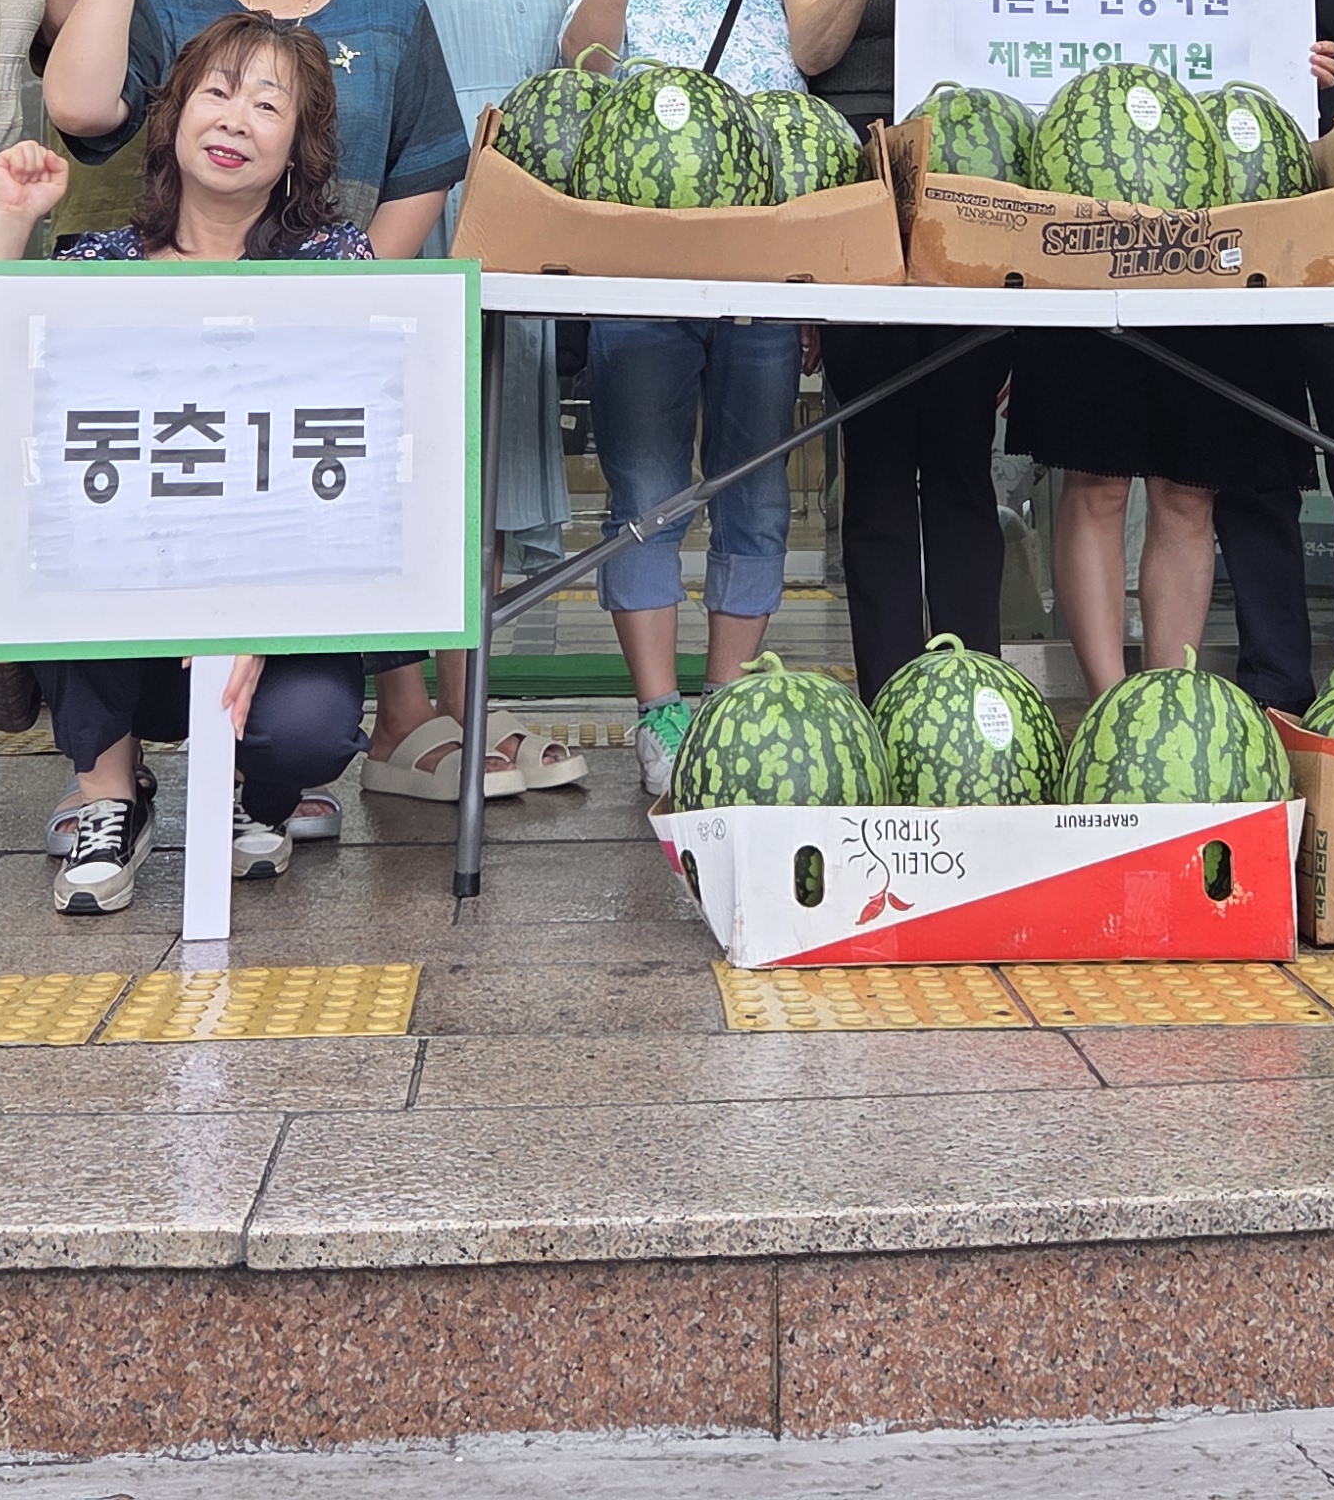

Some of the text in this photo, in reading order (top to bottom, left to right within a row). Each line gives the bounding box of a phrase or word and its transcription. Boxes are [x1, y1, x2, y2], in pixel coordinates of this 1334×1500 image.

[1148, 42, 1213, 81] 지원
[926, 188, 1055, 215] PREMIUM ORANGES
[956, 205, 1028, 227] CALIFORNIA
[1043, 209, 1210, 254] RANCHES
[1110, 229, 1242, 277] BOOTH
[63, 402, 367, 504] 동춘1동
[875, 819, 940, 846] SITRUS
[1055, 814, 1139, 828] GRAPEFRUIT
[891, 851, 966, 879] SOLEIL
